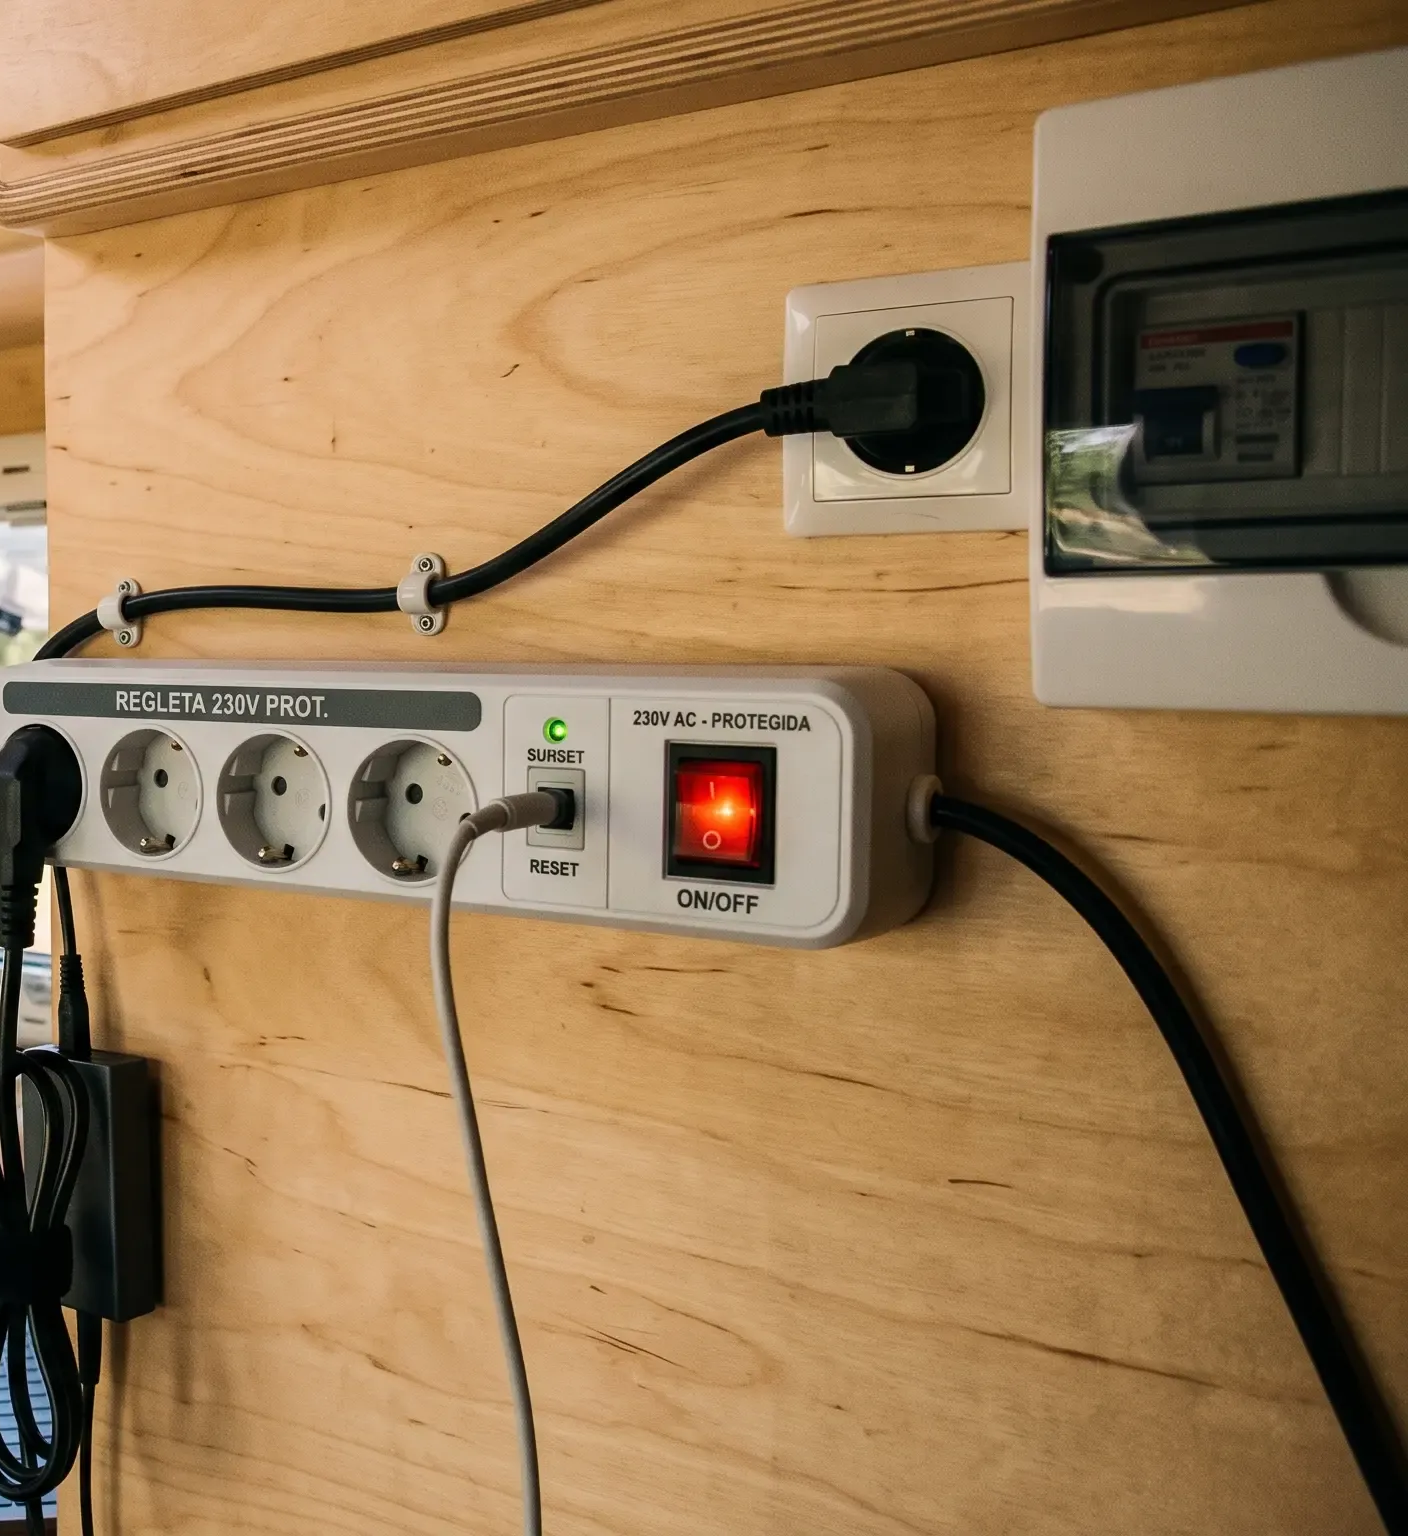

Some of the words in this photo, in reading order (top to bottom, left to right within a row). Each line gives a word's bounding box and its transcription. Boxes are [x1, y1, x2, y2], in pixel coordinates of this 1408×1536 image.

[115, 690, 206, 714] REGLETA
[211, 693, 260, 715] 230V
[266, 694, 328, 718] PROT.
[633, 710, 671, 727] 230V
[673, 711, 697, 728] AC
[711, 712, 811, 731] PROTEGIDA
[527, 747, 585, 764] SURSET
[529, 858, 579, 877] RESET
[677, 888, 759, 914] ON/OFF
